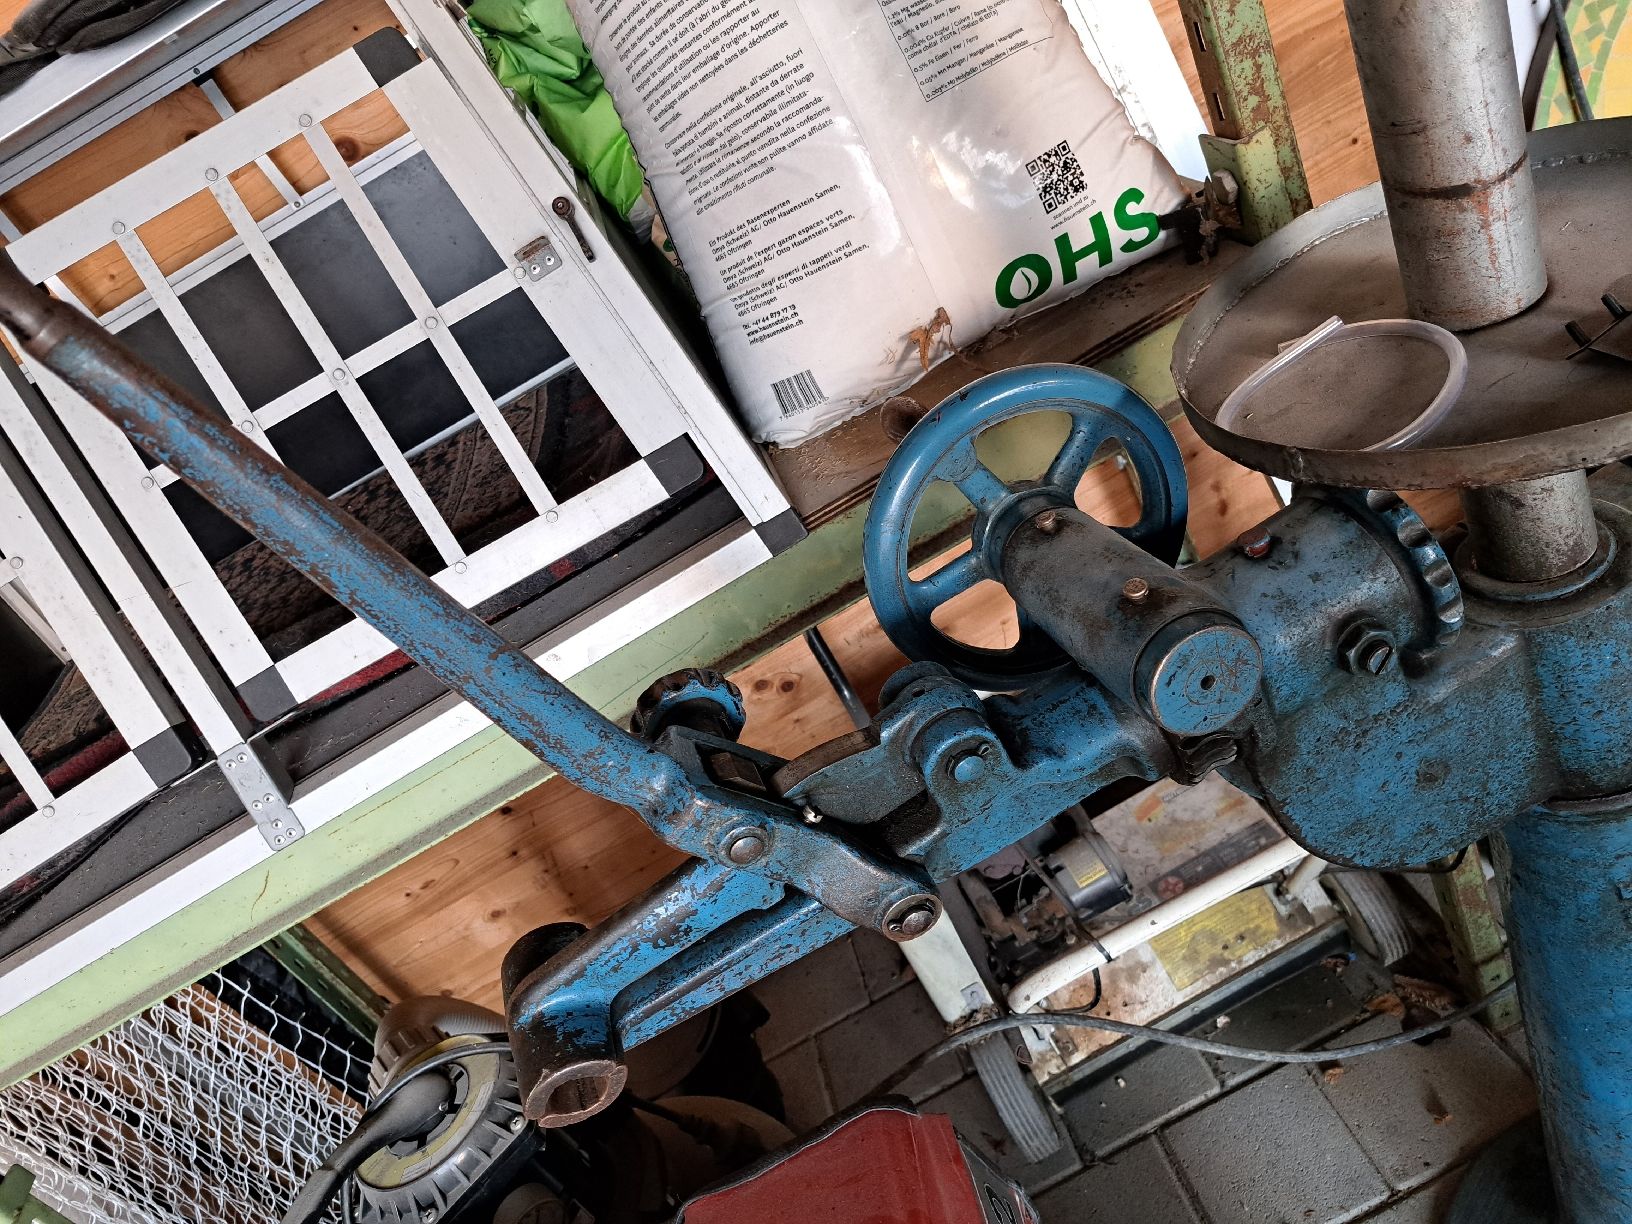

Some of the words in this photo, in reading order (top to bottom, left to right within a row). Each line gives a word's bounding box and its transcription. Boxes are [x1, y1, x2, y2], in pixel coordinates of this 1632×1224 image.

[645, 0, 663, 19] enfants
[668, 22, 677, 30] de
[677, 33, 702, 54] restantes
[702, 0, 747, 35] conformément
[702, 42, 711, 51] ou
[708, 35, 720, 45] les
[719, 14, 749, 38] rapporter
[750, 7, 760, 17] au
[711, 4, 720, 14] du
[692, 50, 720, 74] emballage
[750, 10, 779, 32] Apporter
[724, 52, 739, 66] dans
[737, 46, 748, 56] les
[748, 20, 788, 48] déchetteries
[785, 47, 803, 62] fuori
[742, 90, 785, 120] correttamente
[794, 72, 814, 86] luogo
[744, 85, 769, 104] distante
[769, 79, 779, 88] da
[779, 63, 804, 82] derrate
[740, 149, 757, 164] punto
[756, 136, 780, 152] vendita
[779, 126, 796, 139] nella
[796, 106, 830, 128] confezione
[741, 108, 777, 135] conservabile
[750, 125, 774, 144] secondo
[773, 120, 782, 128] la
[768, 145, 787, 160] pulite
[786, 133, 807, 148] vanno
[807, 118, 833, 136] affidate
[716, 228, 736, 243] Produkt
[736, 223, 746, 232] des
[746, 199, 790, 226] Rasenexperten
[762, 216, 777, 227] Otto
[777, 197, 814, 219] Hauenstein
[814, 184, 840, 199] Samen,
[776, 246, 791, 256] Otto
[791, 227, 828, 248] Hauenstein
[828, 214, 855, 229] Samen,
[777, 233, 797, 247] gazon
[797, 219, 824, 236] espaces
[825, 209, 844, 221] verts
[996, 188, 1160, 309] OHS
[788, 275, 804, 284] Otto
[804, 256, 842, 277] Hauenstein
[843, 244, 869, 258] Samen,
[801, 262, 808, 270] di
[808, 251, 833, 266] tappeti
[833, 240, 852, 253] verdi
[761, 315, 769, 323] 44
[769, 310, 781, 318] 879
